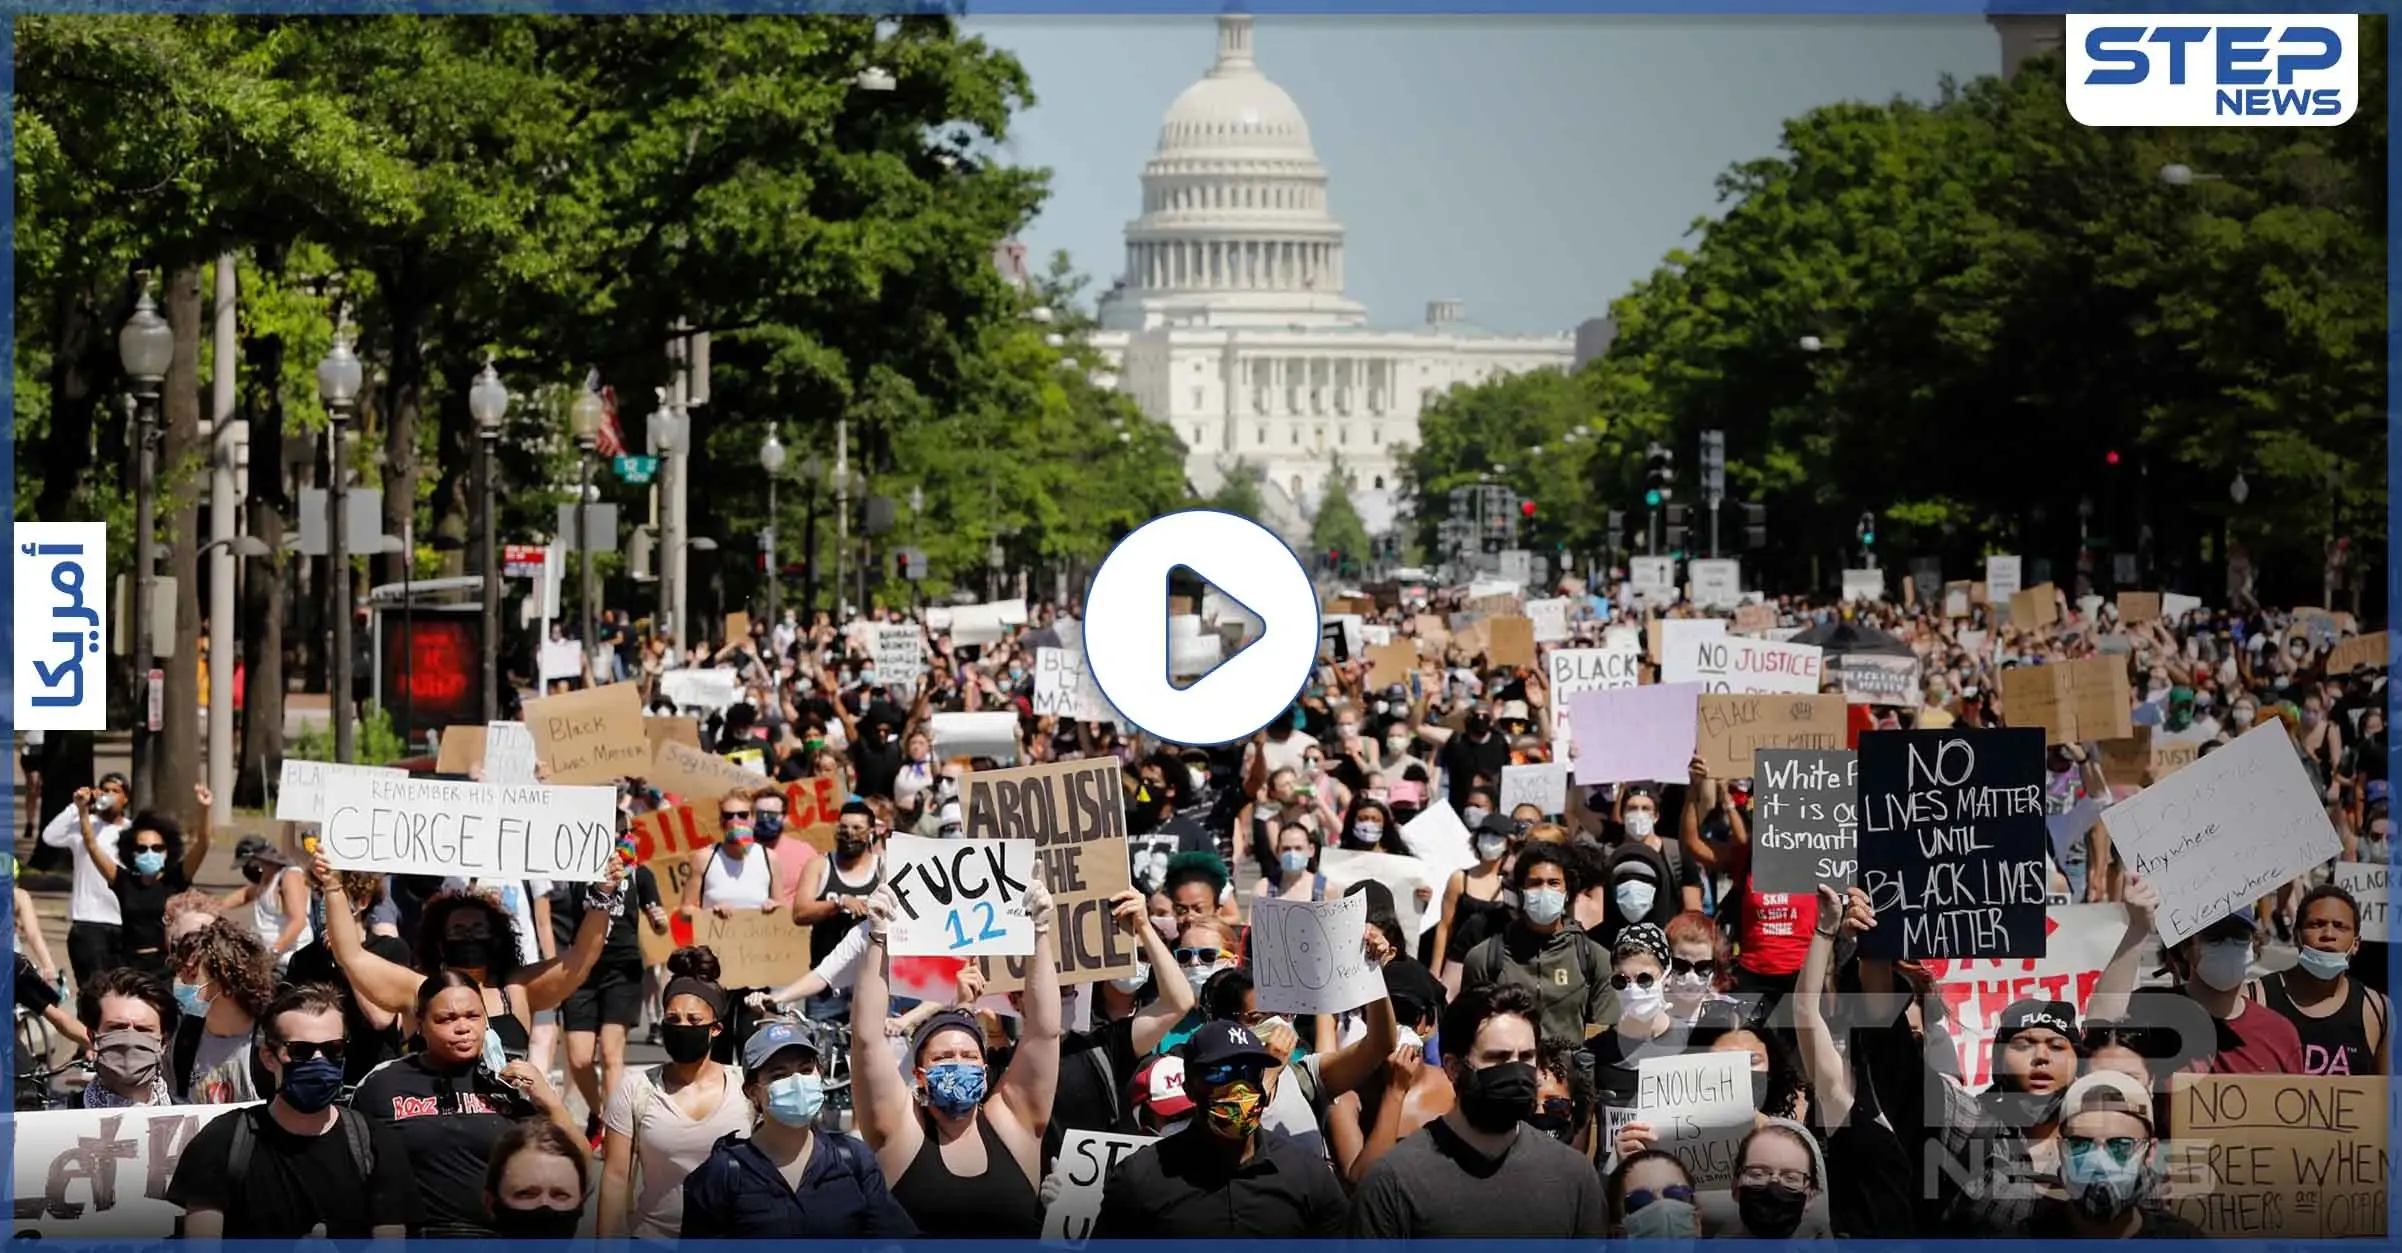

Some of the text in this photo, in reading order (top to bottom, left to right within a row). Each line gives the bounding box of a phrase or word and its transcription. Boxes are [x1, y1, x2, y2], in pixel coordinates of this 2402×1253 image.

[1556, 653, 1637, 682] BLACK
[1698, 643, 1819, 677] NO JUSTICE
[549, 716, 607, 741] Black
[1764, 759, 1841, 791] White
[1908, 738, 1975, 791] NO
[372, 779, 552, 805] REMEMBER HIS NAME
[966, 766, 1125, 848] ABOLISH
[1763, 793, 1789, 820] it
[1800, 797, 1825, 821] is
[1865, 784, 2043, 832] LIVES MATTER
[329, 806, 611, 874] GEORGE FLOYD
[1917, 824, 1995, 858] UNTIL
[2135, 822, 2220, 875] Anywhere
[887, 842, 1027, 920] FUCK
[1763, 893, 1789, 906] SKIN
[1865, 859, 2046, 913] BLACK LIVES
[2170, 866, 2284, 937] Everywhere
[944, 900, 1007, 950] 12
[1253, 903, 1334, 991] NO
[1903, 907, 2011, 959] MATTER
[1554, 968, 1568, 986] G
[1227, 1026, 1249, 1045] NY
[1164, 1072, 1183, 1090] M
[1641, 1065, 1735, 1110] ENOUGH
[1672, 1114, 1702, 1142] IS
[2189, 1081, 2248, 1124] NO
[2274, 1086, 2365, 1131] ONE
[2178, 1139, 2397, 1187] FREE WHEN
[2177, 1189, 2285, 1233] OTHERS
